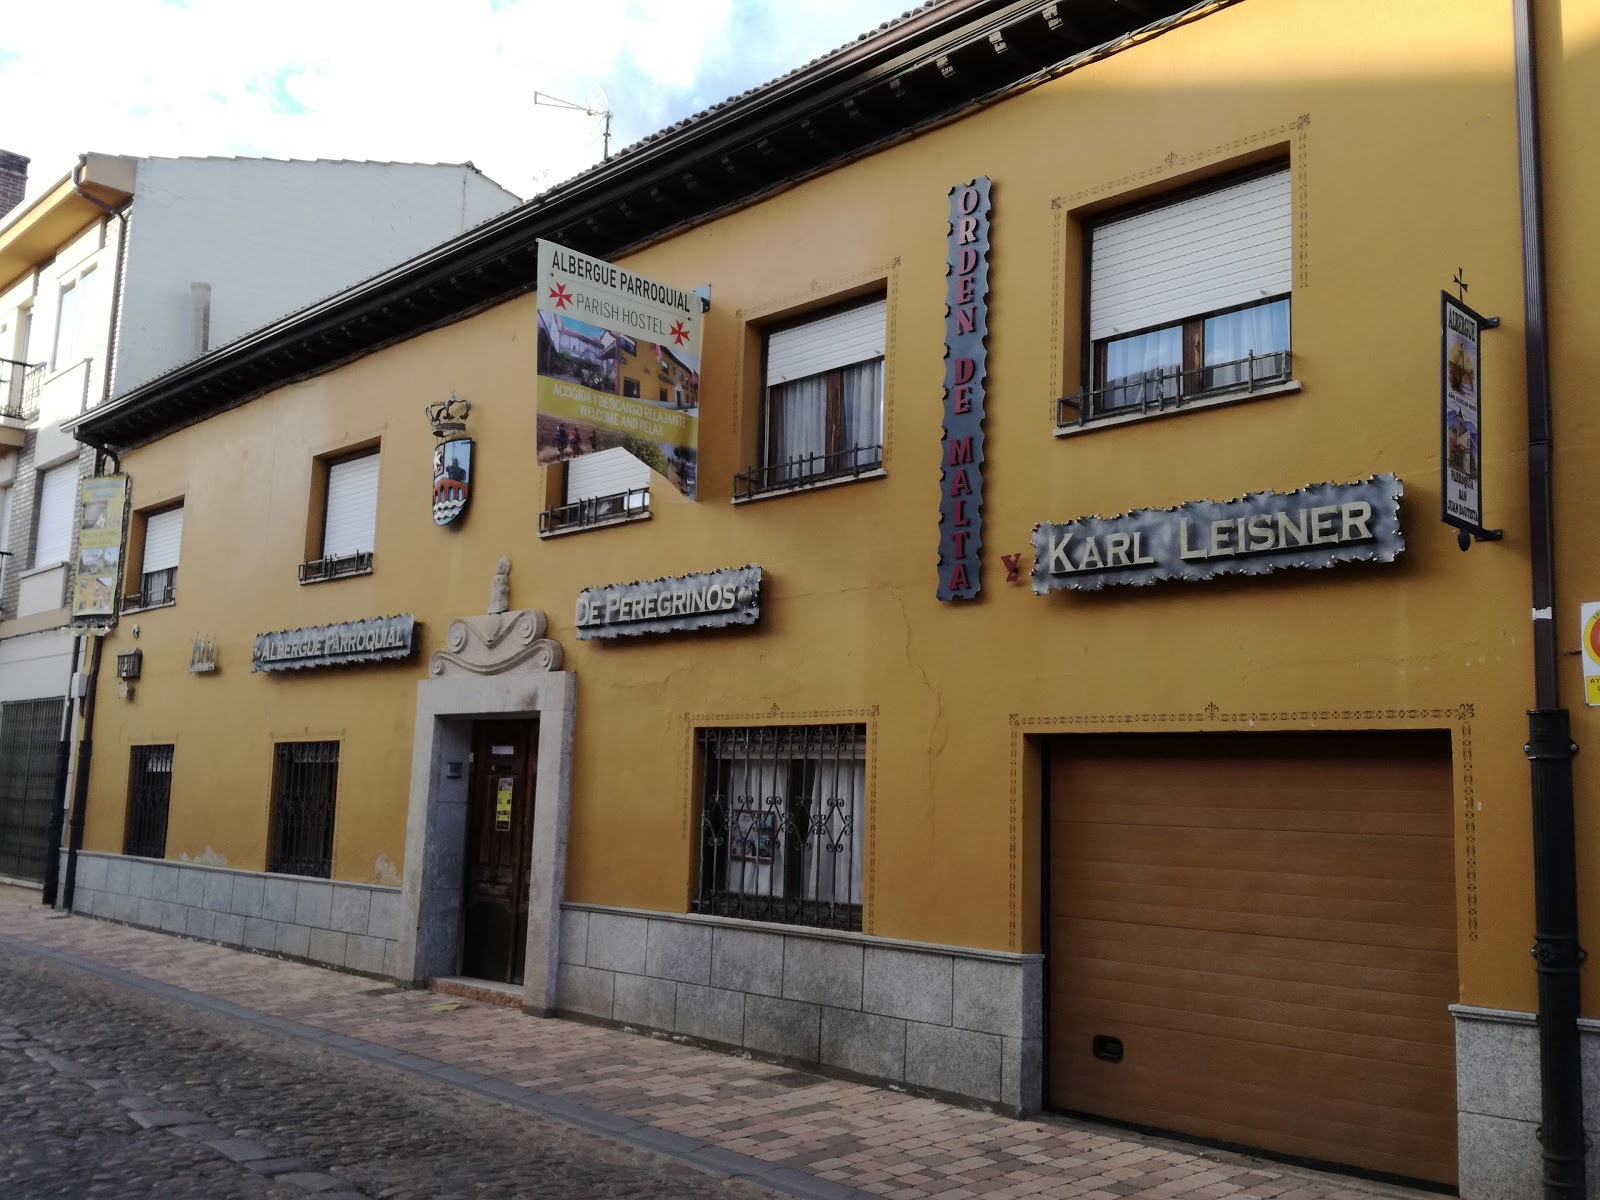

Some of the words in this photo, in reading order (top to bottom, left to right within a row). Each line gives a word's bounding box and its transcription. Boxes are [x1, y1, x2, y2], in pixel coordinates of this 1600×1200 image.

[552, 250, 617, 289] ALBERGUE
[620, 272, 690, 313] PARROQUIAL
[956, 187, 978, 335] ORDEN
[576, 293, 619, 322] PARISH
[622, 309, 666, 336] HOSTEL
[553, 383, 592, 404] ACOGIDA
[592, 394, 598, 405] Y
[599, 396, 643, 417] DESCANSO
[644, 407, 686, 429] RELAJANTE
[953, 357, 975, 415] DE
[579, 404, 619, 426] WELCOME
[621, 416, 639, 430] AND
[640, 421, 664, 437] RELAX
[948, 435, 973, 591] MALTA
[1048, 531, 1155, 575] KARL
[1179, 501, 1373, 560] LEISNER
[1001, 553, 1021, 583] Y
[575, 597, 601, 627] DE
[604, 583, 737, 623] PEREGRINOS
[260, 636, 322, 662] ALBERGUE
[325, 626, 404, 654] PARROQUIAL
